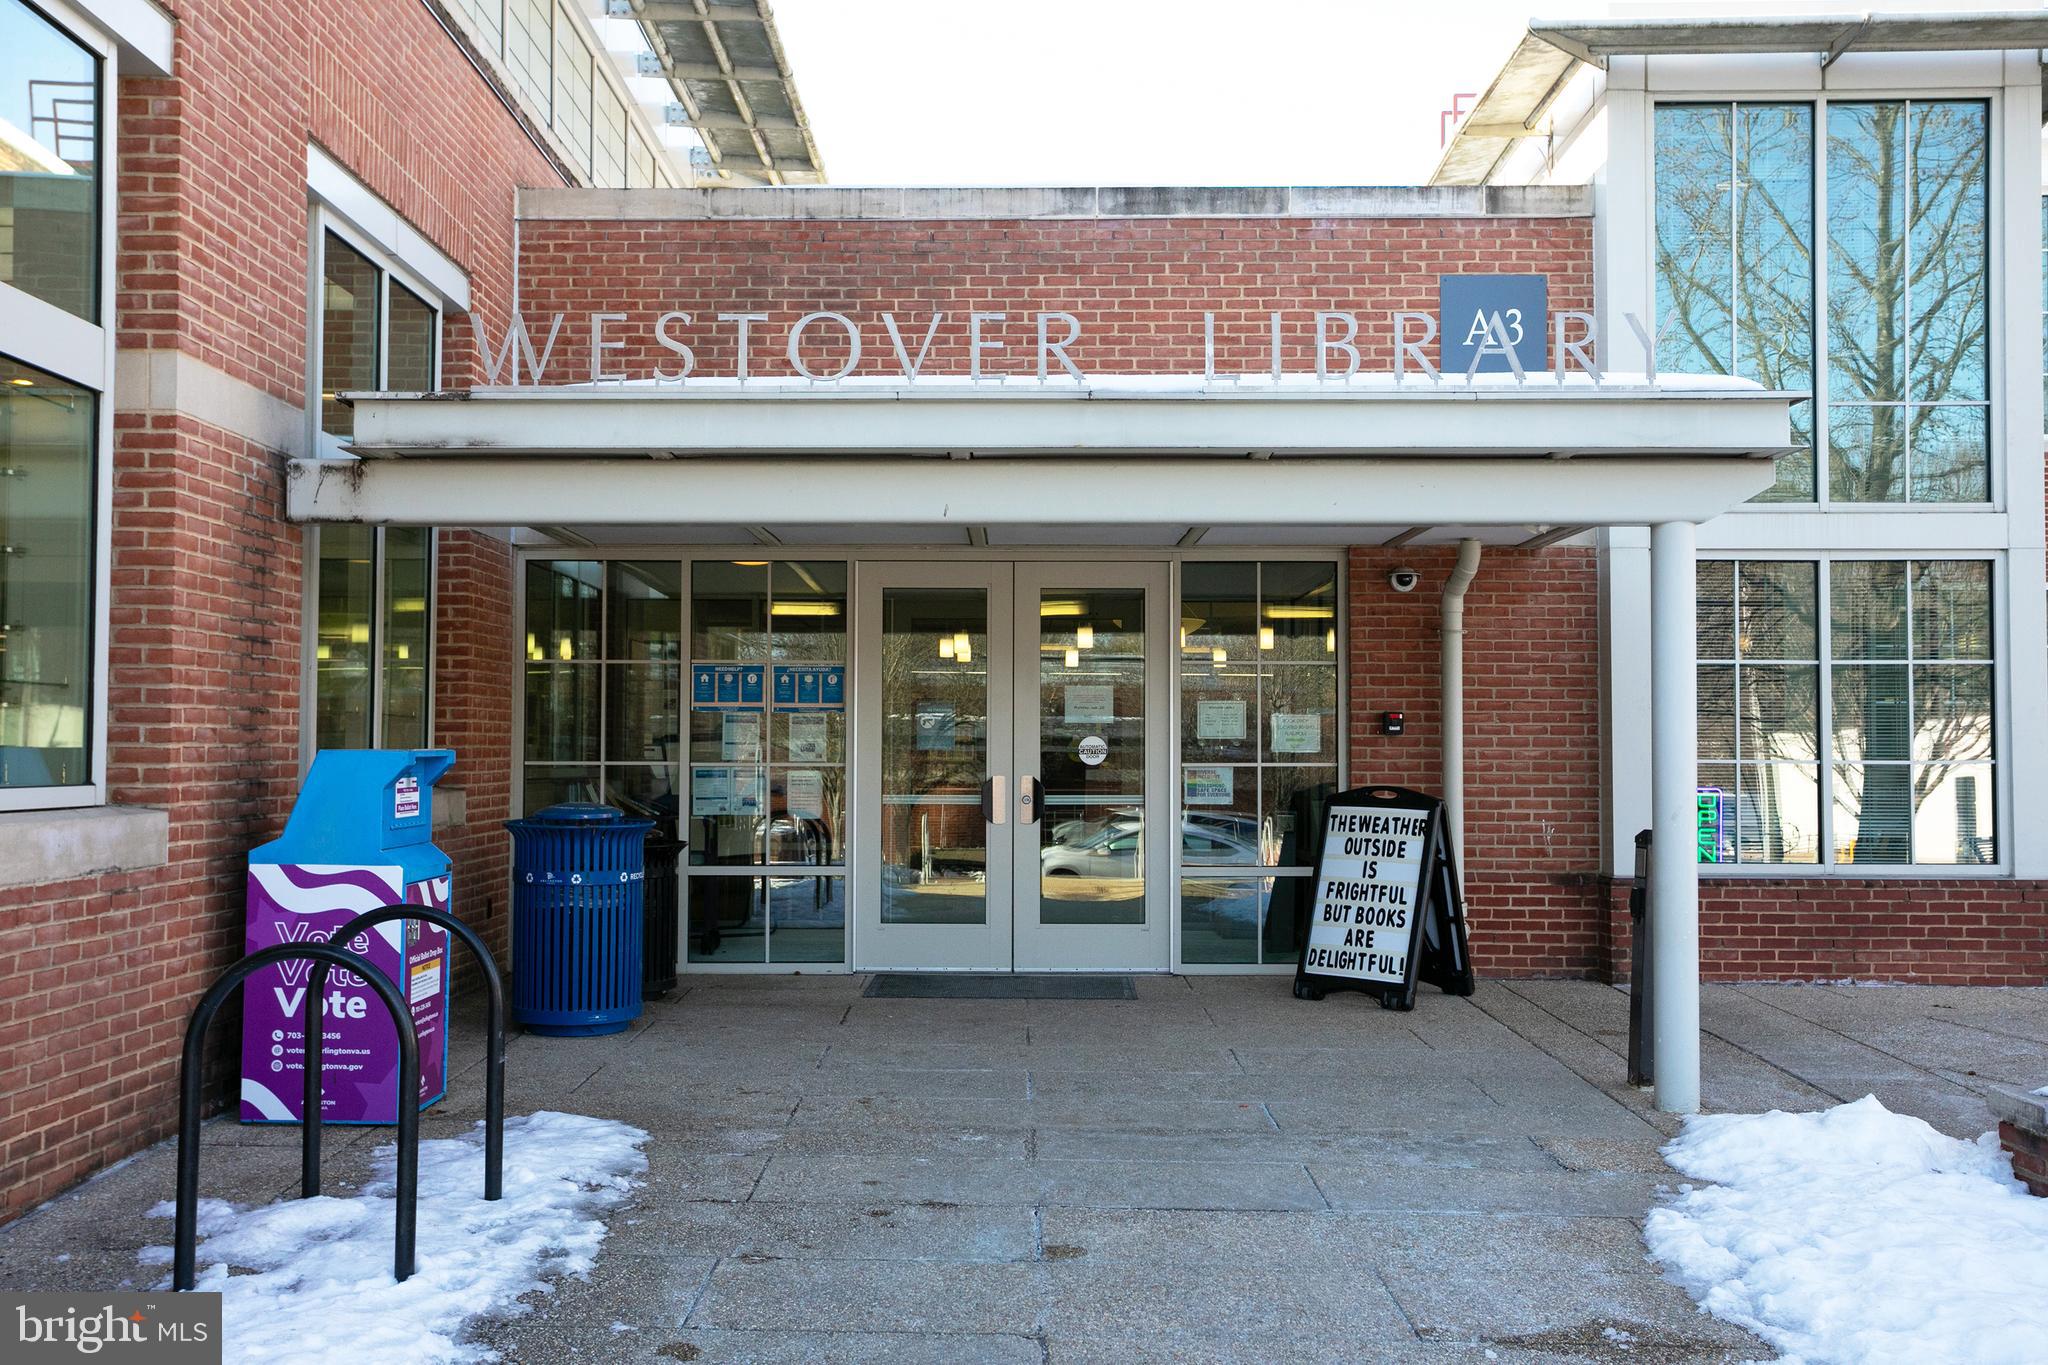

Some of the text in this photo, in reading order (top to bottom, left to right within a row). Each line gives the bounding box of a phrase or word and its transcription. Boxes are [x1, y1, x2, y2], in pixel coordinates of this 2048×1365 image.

[469, 310, 1678, 382] WESTOVER LIBRARY
[1344, 837, 1407, 858] OUTSIDE
[1362, 861, 1378, 879] IS
[1326, 881, 1407, 905] FRIGHTFUL
[1323, 904, 1406, 928] BUT BOOKS
[1343, 928, 1375, 948] ARE
[1307, 948, 1405, 976] DELIGHTFUL!
[273, 987, 367, 1019] Vte
